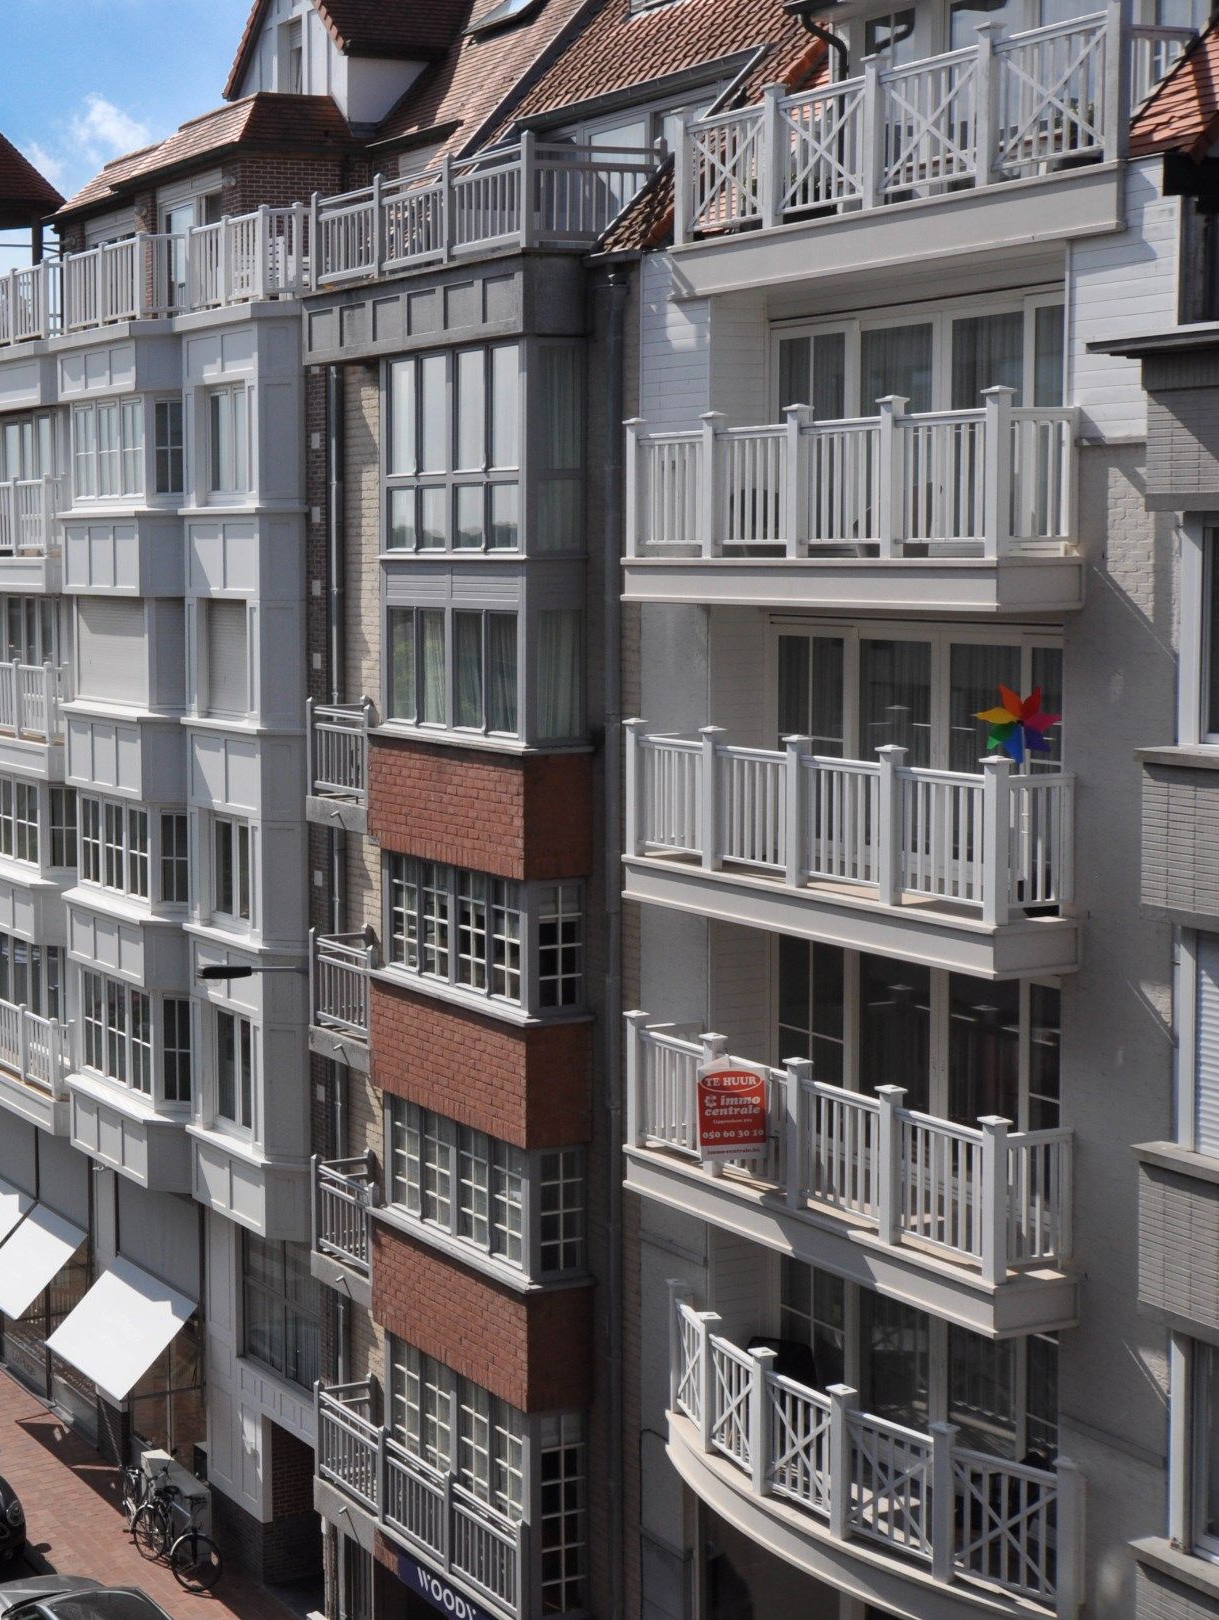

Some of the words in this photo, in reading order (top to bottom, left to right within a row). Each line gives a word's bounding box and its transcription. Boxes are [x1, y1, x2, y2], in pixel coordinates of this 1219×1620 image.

[705, 1077, 720, 1087] TE
[723, 1076, 757, 1086] HUUR
[720, 1095, 761, 1106] immo
[704, 1104, 761, 1116] centrale
[702, 1131, 720, 1140] 050
[723, 1130, 735, 1138] 60
[737, 1130, 750, 1138] 30
[753, 1129, 764, 1137] 10
[417, 1566, 477, 1620] WOODY
